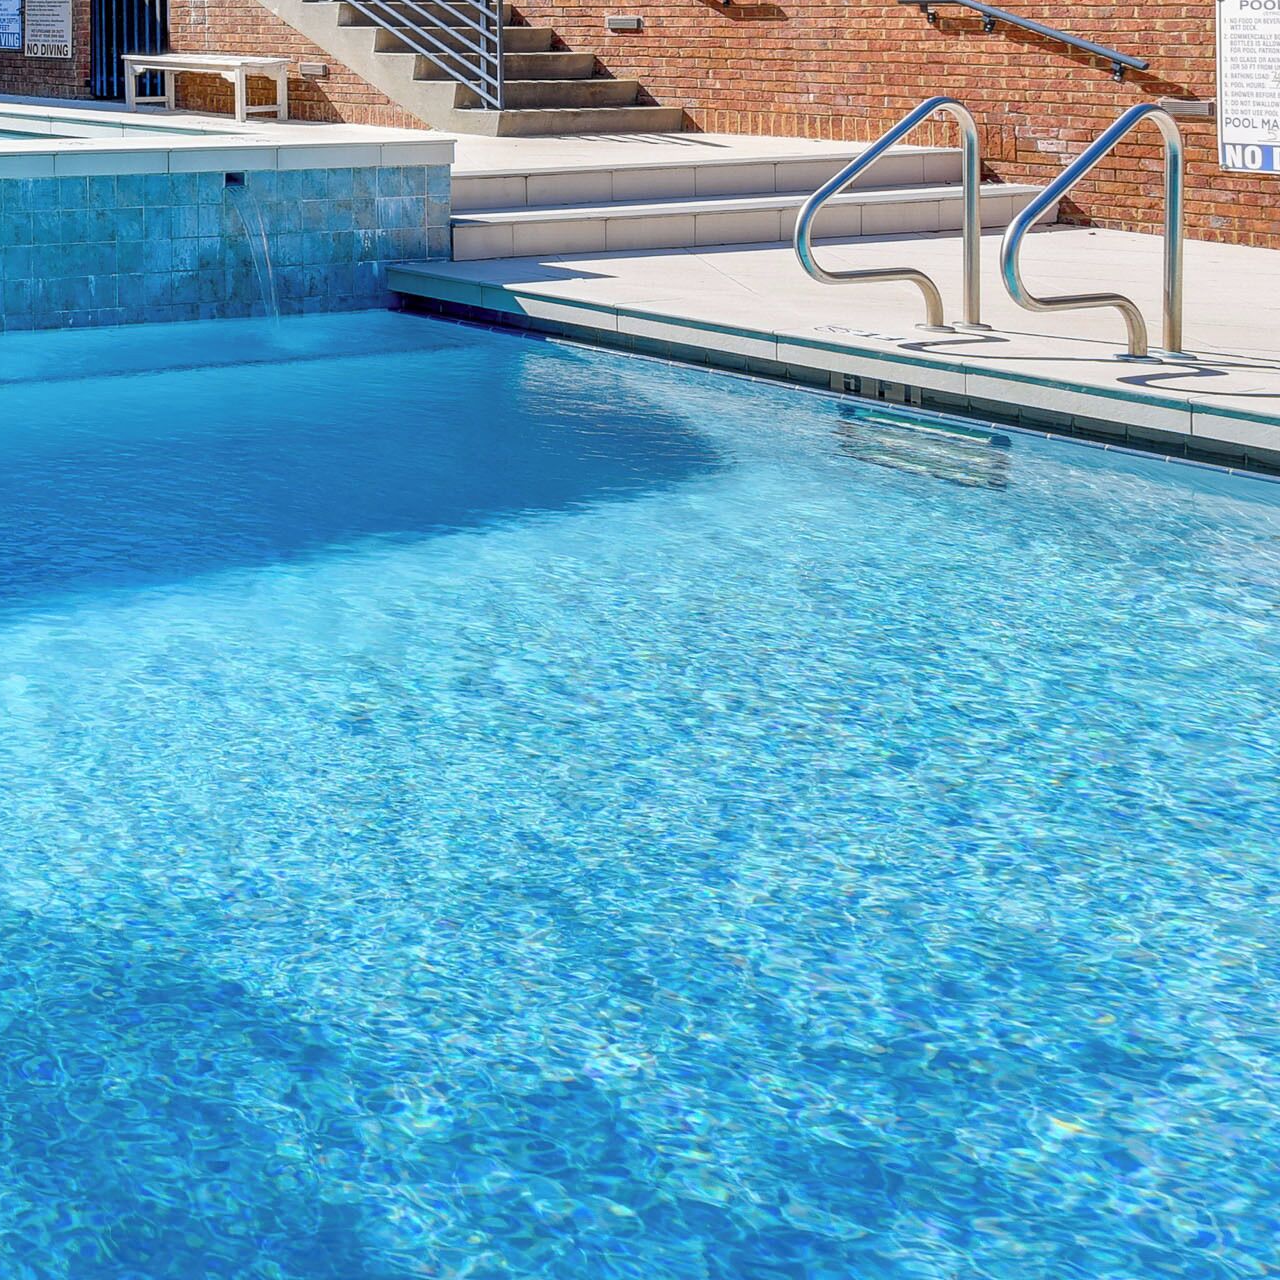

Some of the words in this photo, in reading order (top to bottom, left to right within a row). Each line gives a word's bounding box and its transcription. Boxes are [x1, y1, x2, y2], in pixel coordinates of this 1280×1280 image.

[27, 43, 39, 55] NO
[41, 44, 69, 57] DIVING
[1225, 117, 1258, 128] POOL
[1225, 144, 1263, 170] NO
